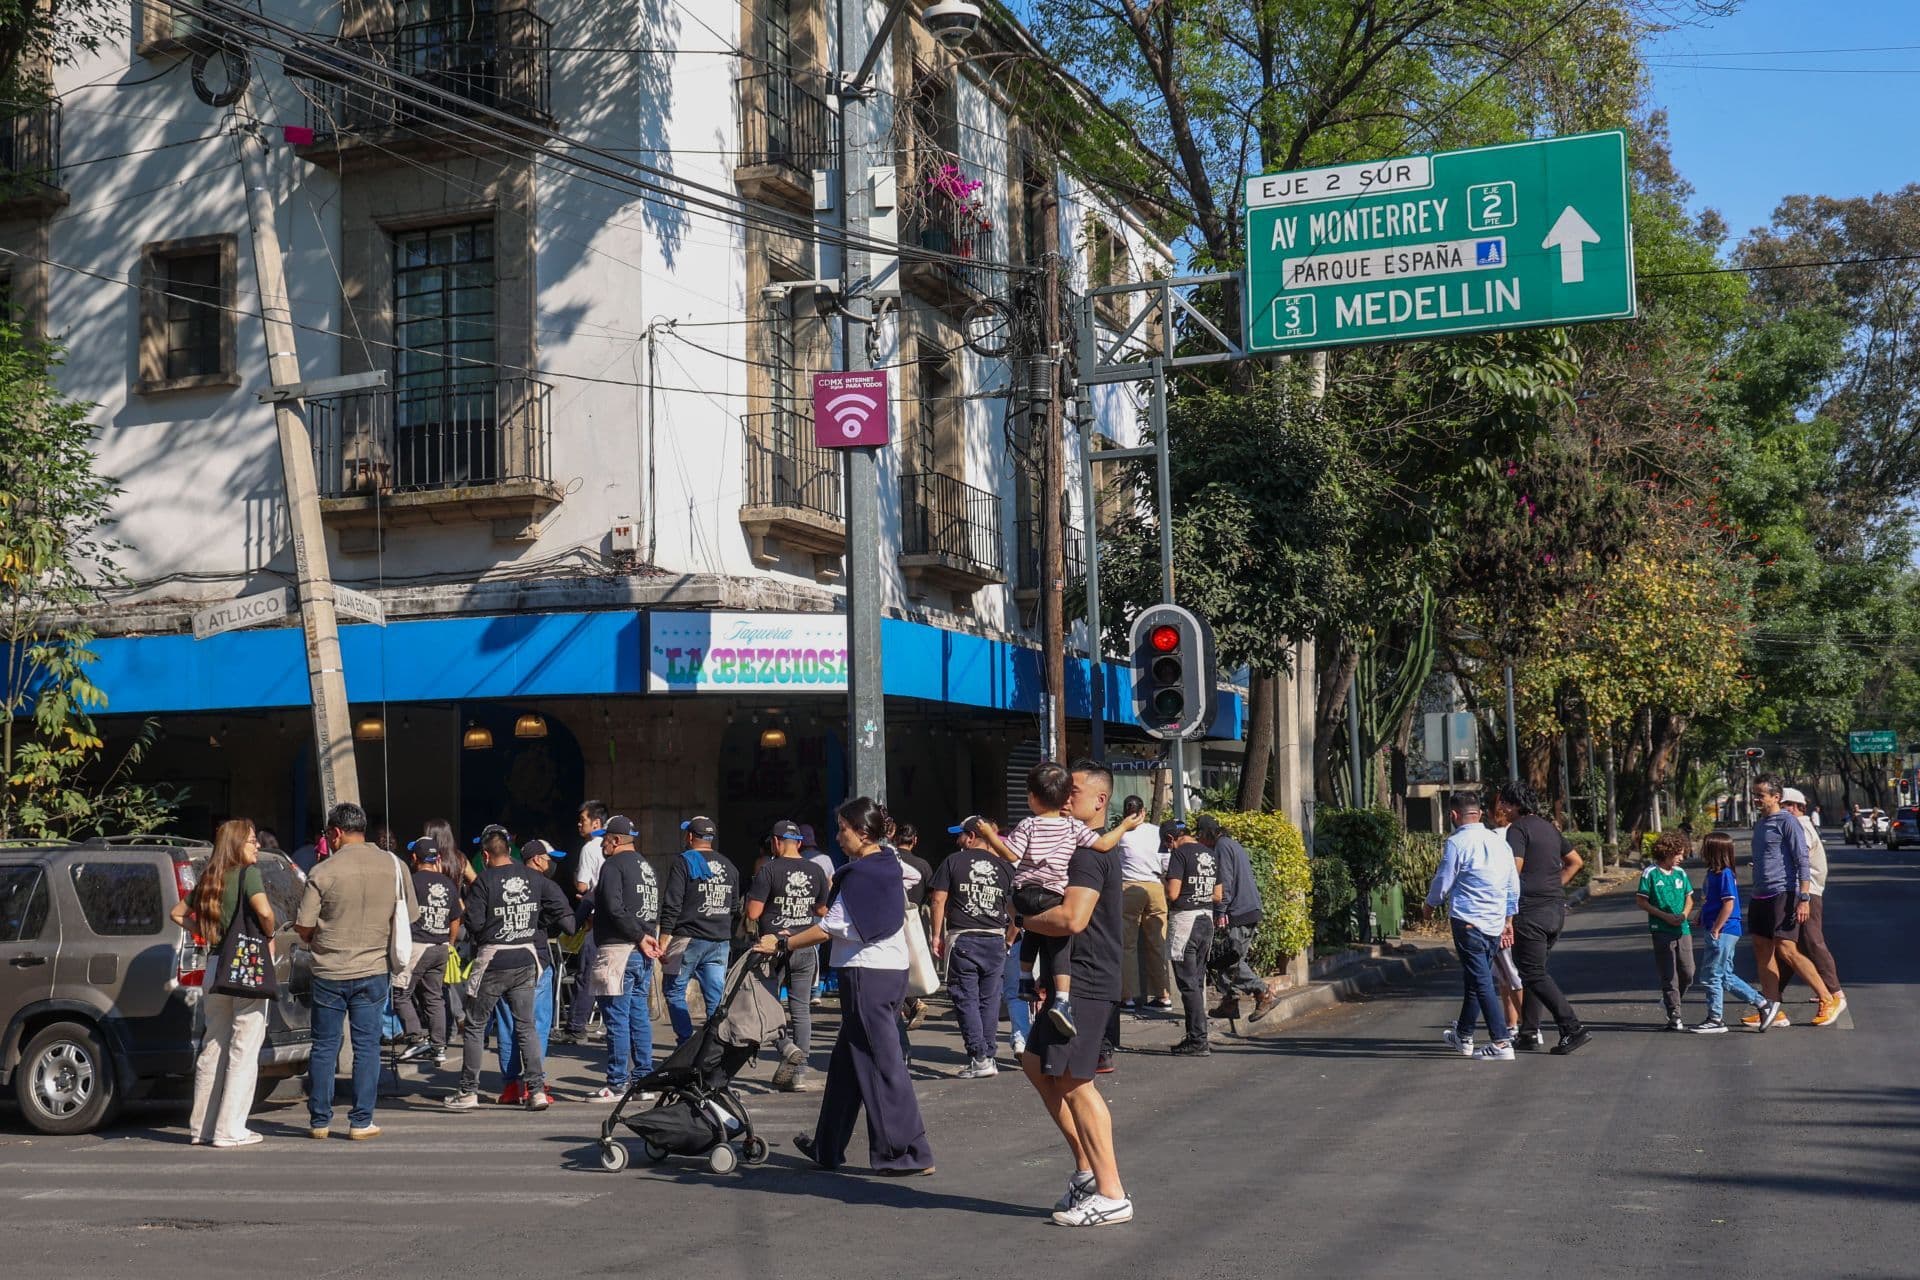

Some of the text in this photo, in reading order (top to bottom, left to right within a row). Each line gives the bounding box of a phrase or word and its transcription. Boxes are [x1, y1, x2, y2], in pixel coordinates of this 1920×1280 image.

[1263, 165, 1411, 199] EJE 2 SUR
[1483, 186, 1499, 195] EJE
[1482, 194, 1502, 219] 2
[1271, 198, 1449, 251] AV MONTERREY
[1484, 217, 1501, 226] PTE
[1294, 244, 1463, 283] PARQUE ESPAÑA
[1284, 277, 1521, 329] 3 MEDELLIN
[1285, 298, 1301, 306] EJE
[1286, 327, 1302, 336] PTE
[818, 379, 843, 387] CDMX
[209, 597, 280, 629] ATLIXCO
[666, 647, 708, 684] LA
[516, 902, 538, 913] NORTE
